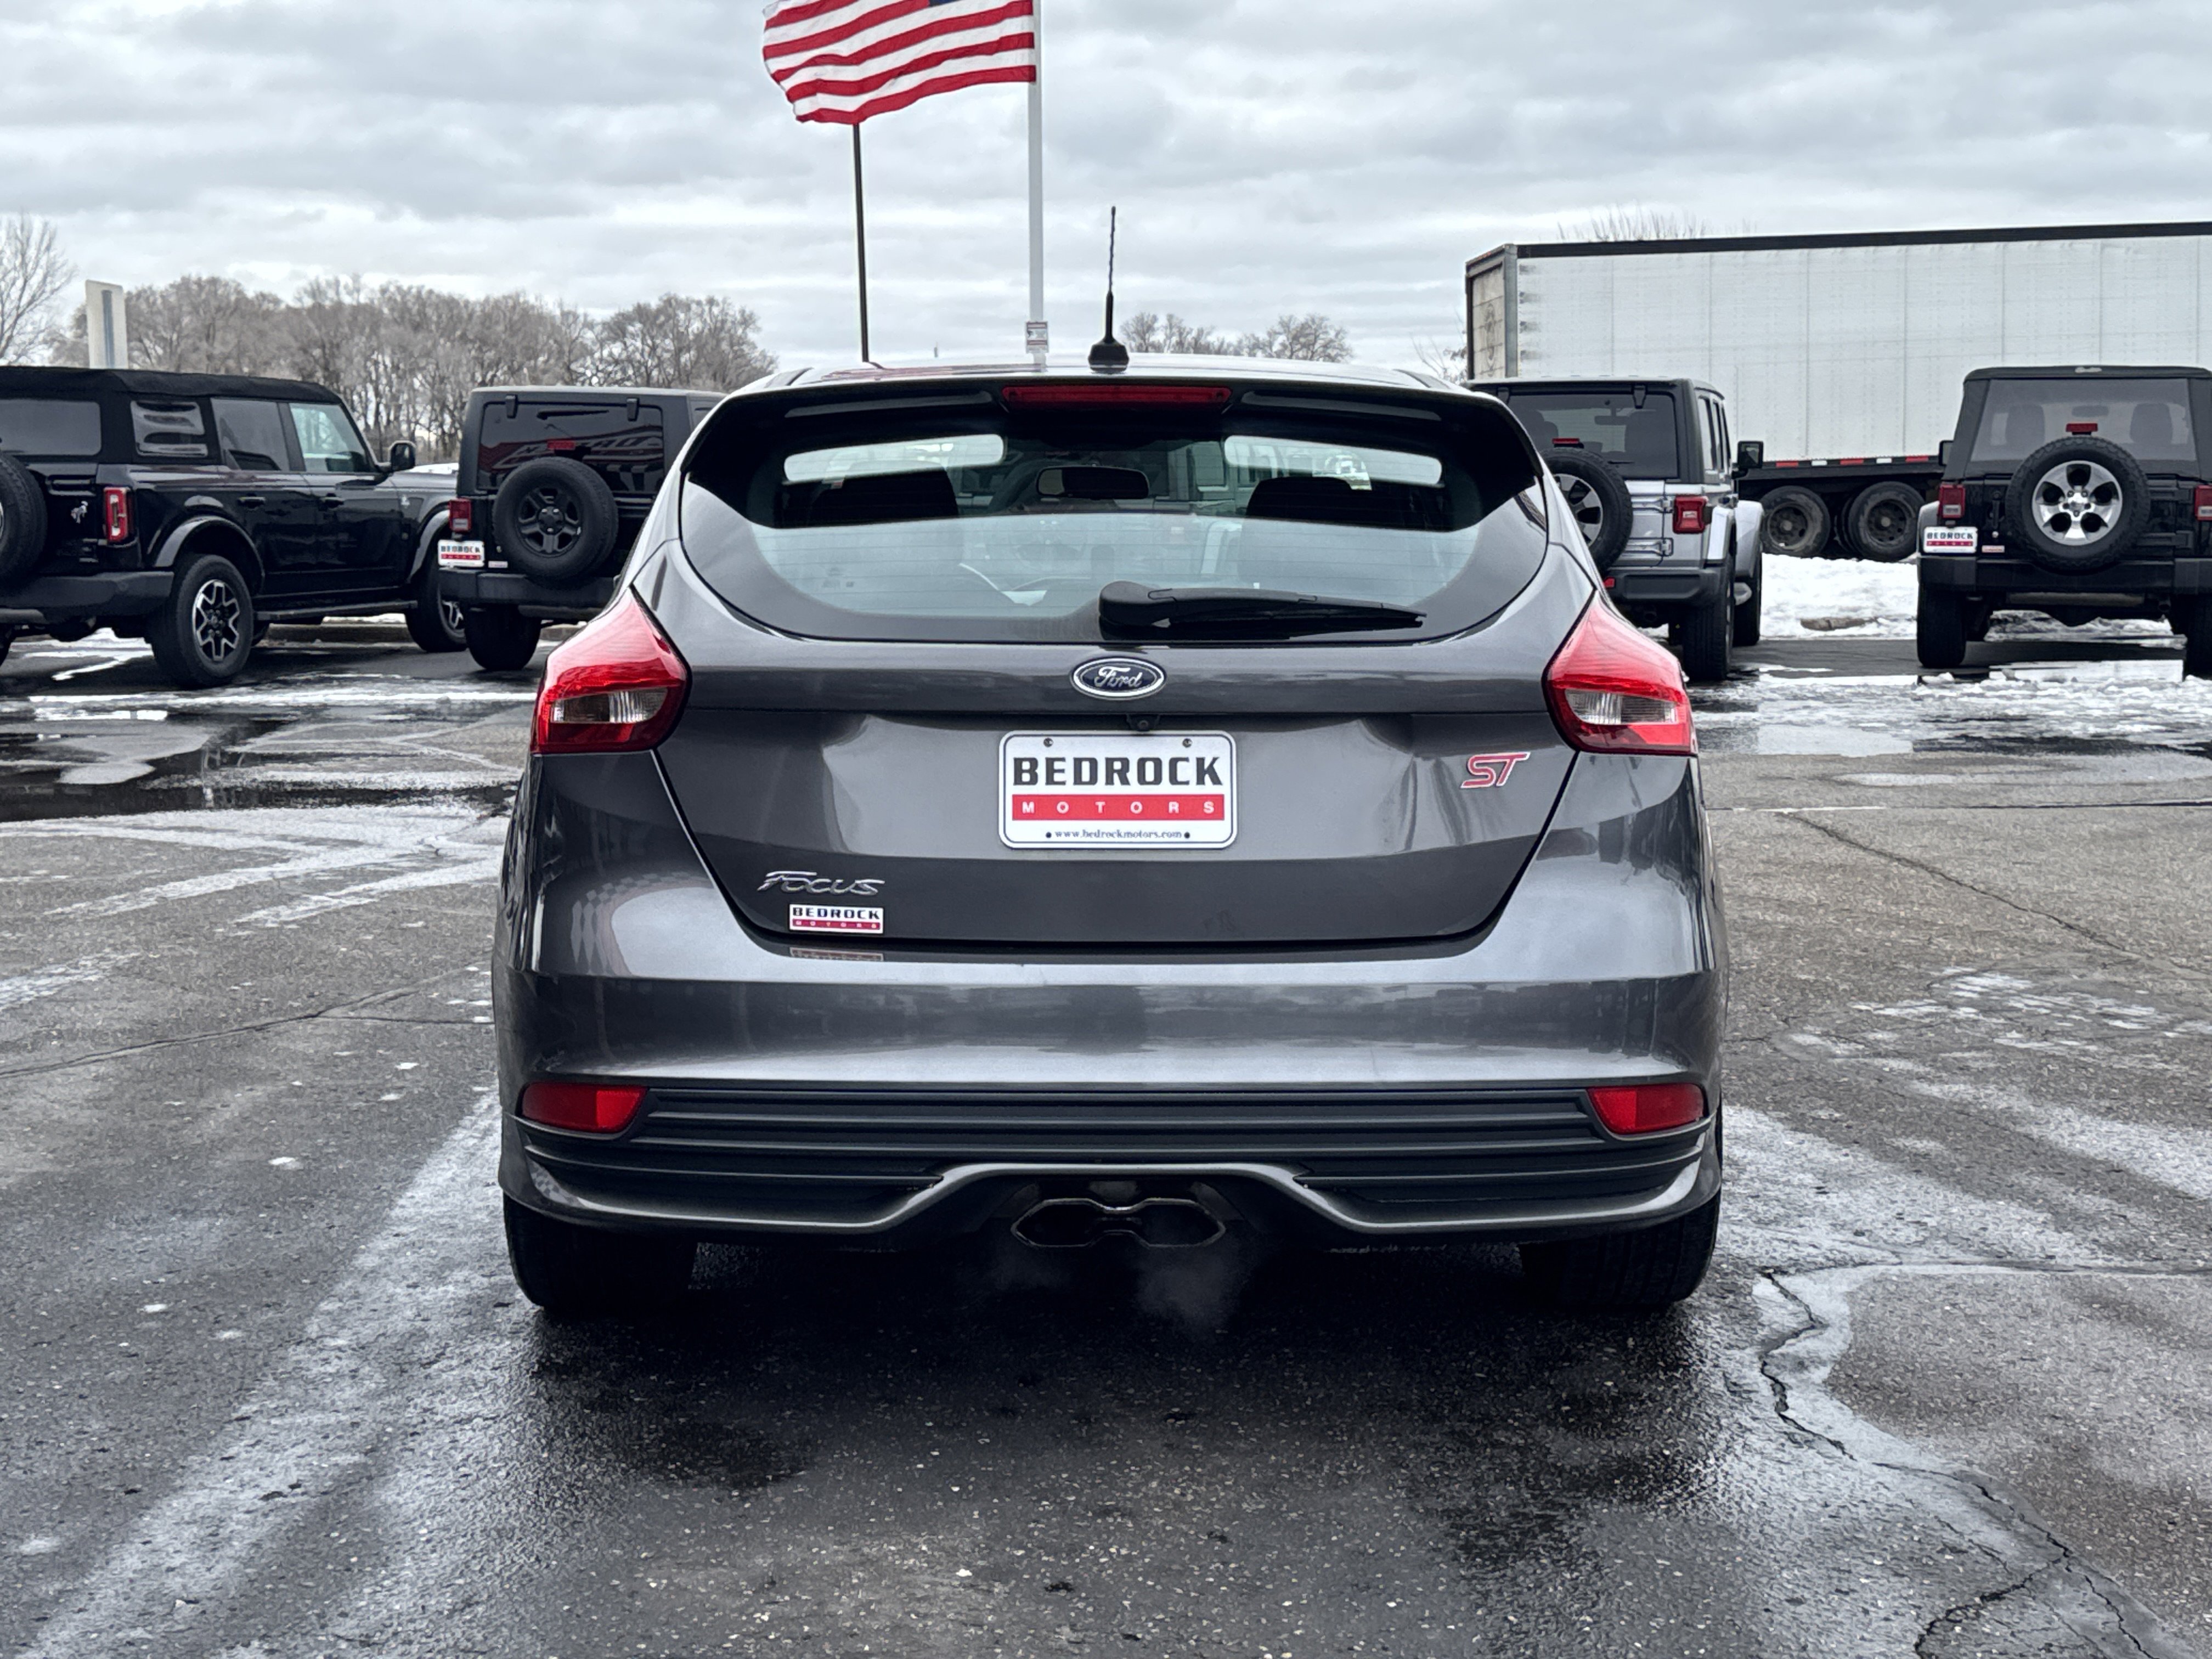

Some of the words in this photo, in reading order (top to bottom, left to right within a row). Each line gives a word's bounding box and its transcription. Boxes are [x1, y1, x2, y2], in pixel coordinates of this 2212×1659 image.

[1094, 666, 1143, 688] Ford
[1013, 757, 1223, 786] BEDROCK
[1460, 752, 1531, 788] ST
[1022, 801, 1215, 814] MOTORS
[1054, 829, 1182, 839] www.bedrockmotors.com
[757, 871, 885, 895] Focus
[792, 907, 880, 919] BEDROCK
